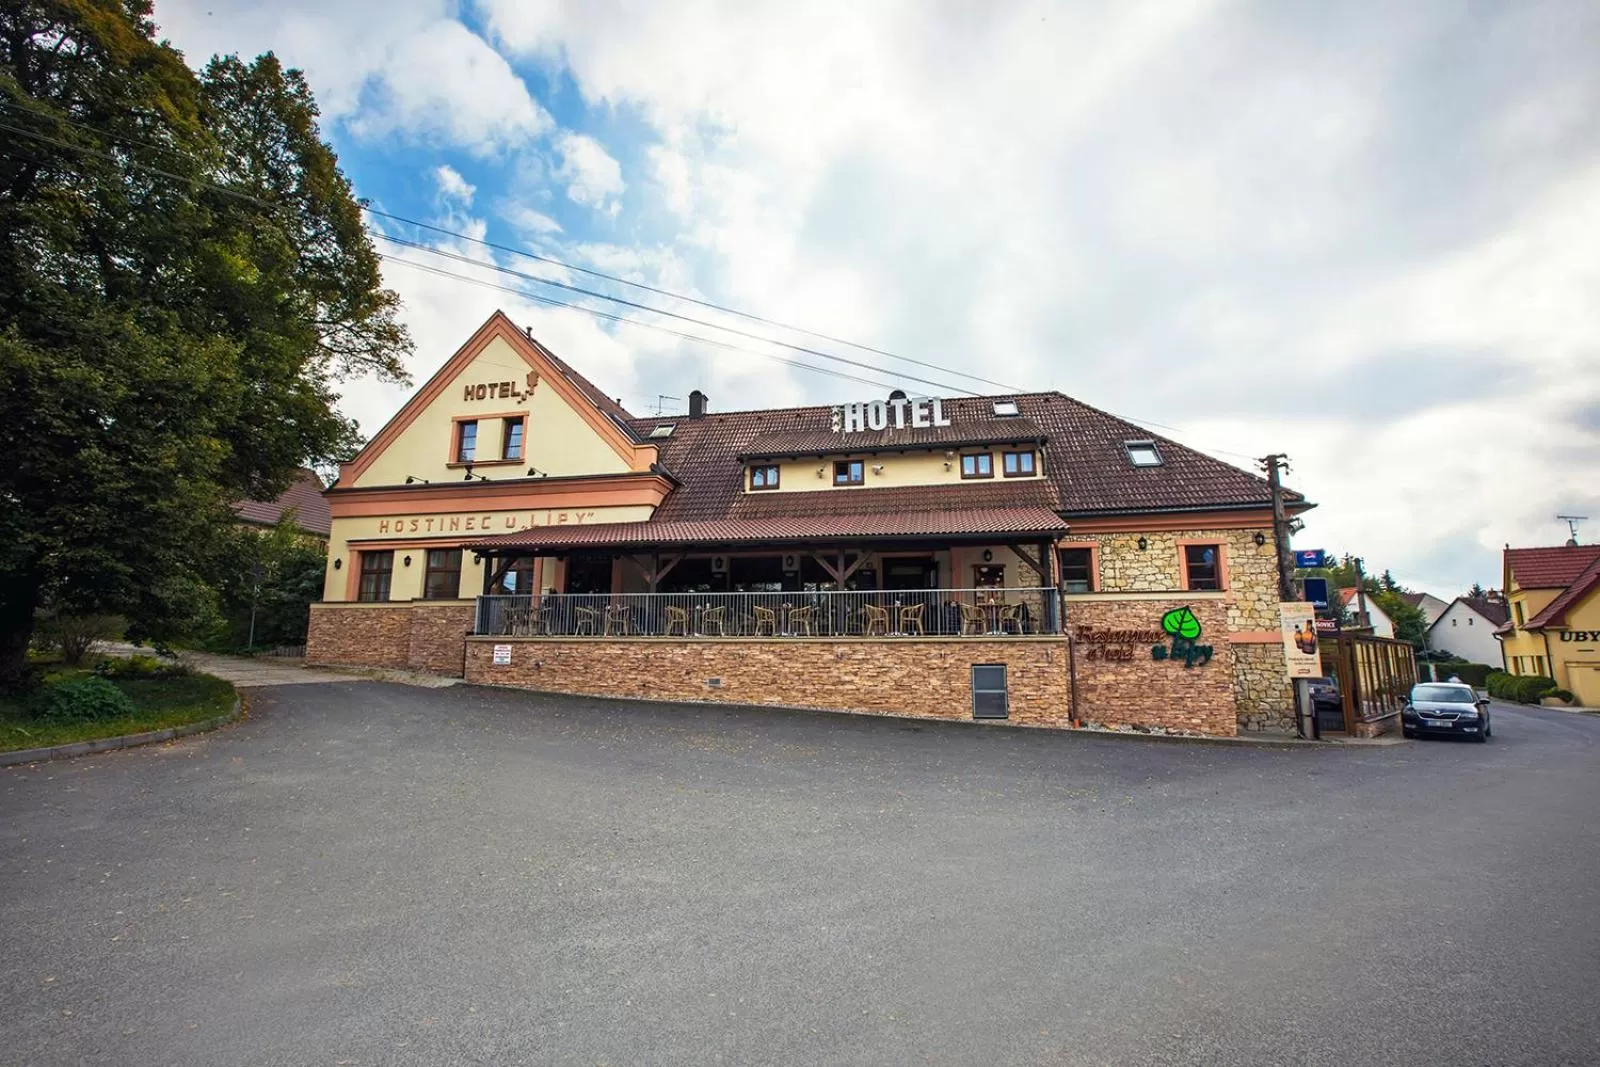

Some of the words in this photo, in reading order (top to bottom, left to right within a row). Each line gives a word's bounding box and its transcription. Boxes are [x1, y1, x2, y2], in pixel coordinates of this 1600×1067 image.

[463, 381, 521, 402] HOTEL
[844, 396, 951, 433] HOTEL
[379, 516, 492, 534] HOSTINEC
[1560, 630, 1600, 642] UBY
